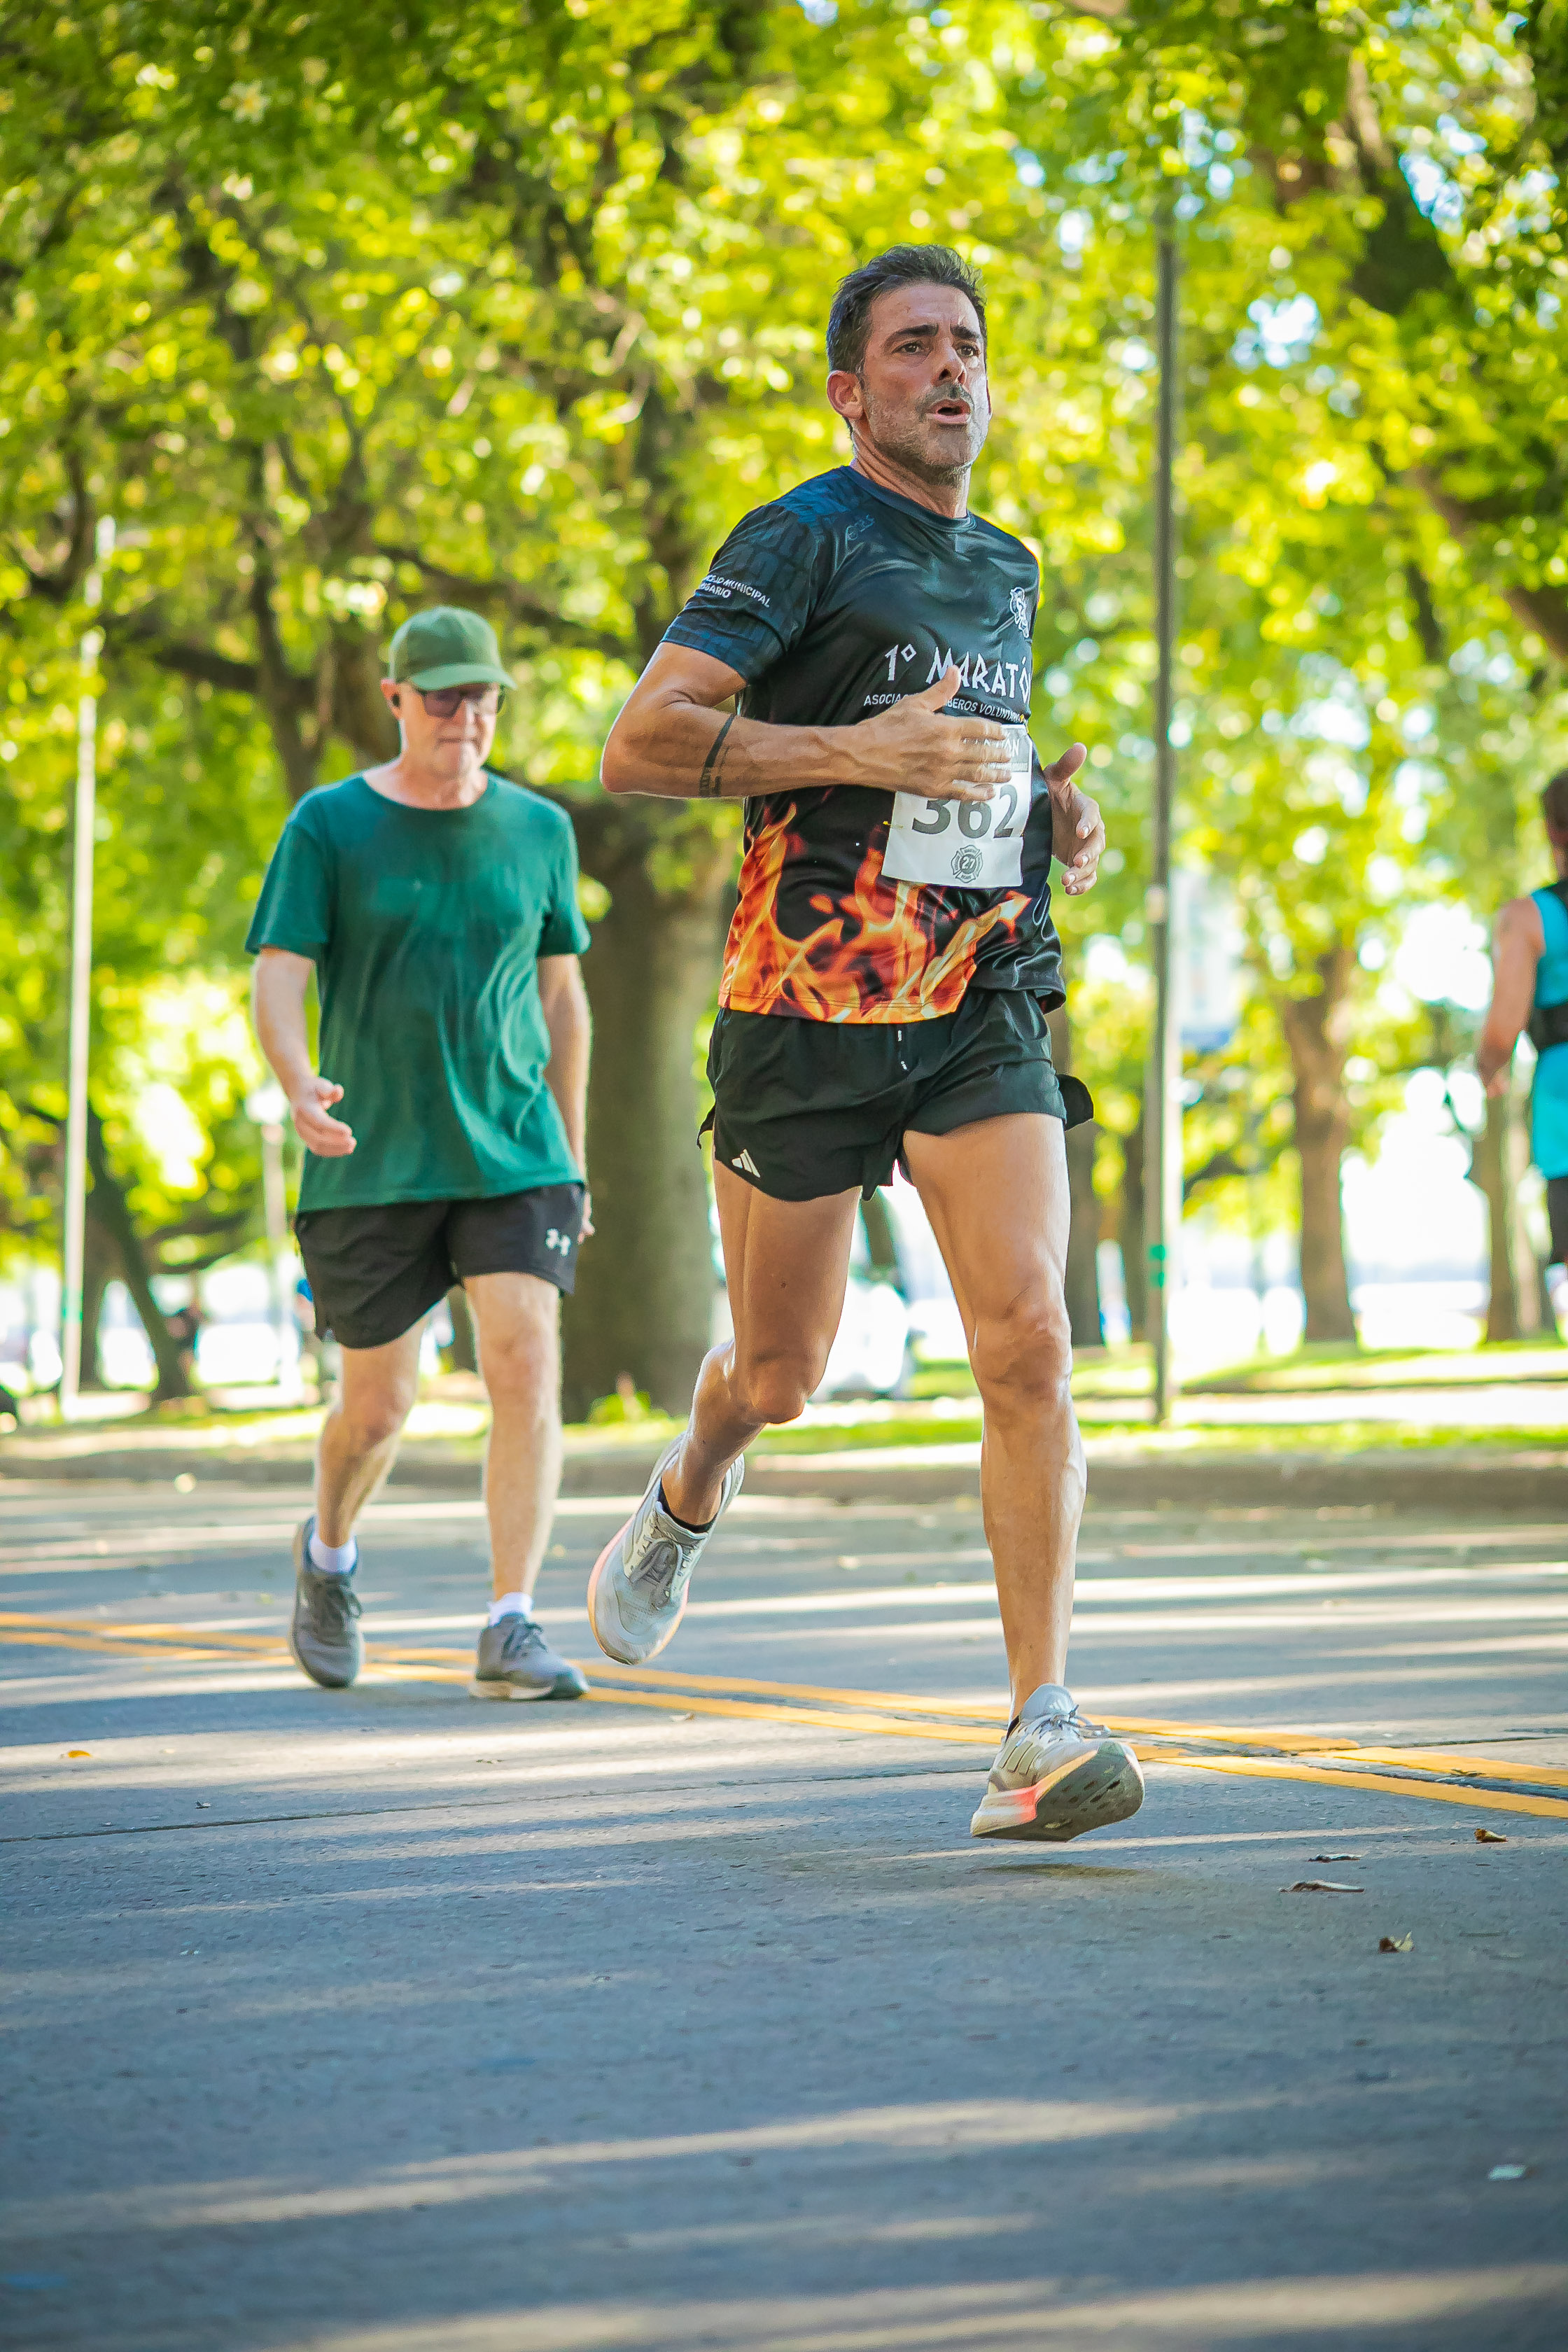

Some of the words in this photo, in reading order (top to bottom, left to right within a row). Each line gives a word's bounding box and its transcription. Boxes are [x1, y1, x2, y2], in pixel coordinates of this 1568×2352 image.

[723, 579, 771, 608] MUNICIPAL
[925, 646, 1032, 704] MARATÓ
[863, 693, 909, 706] ASOCIA
[946, 698, 979, 712] BEROS
[912, 784, 1018, 839] 362
[961, 856, 976, 870] 27
